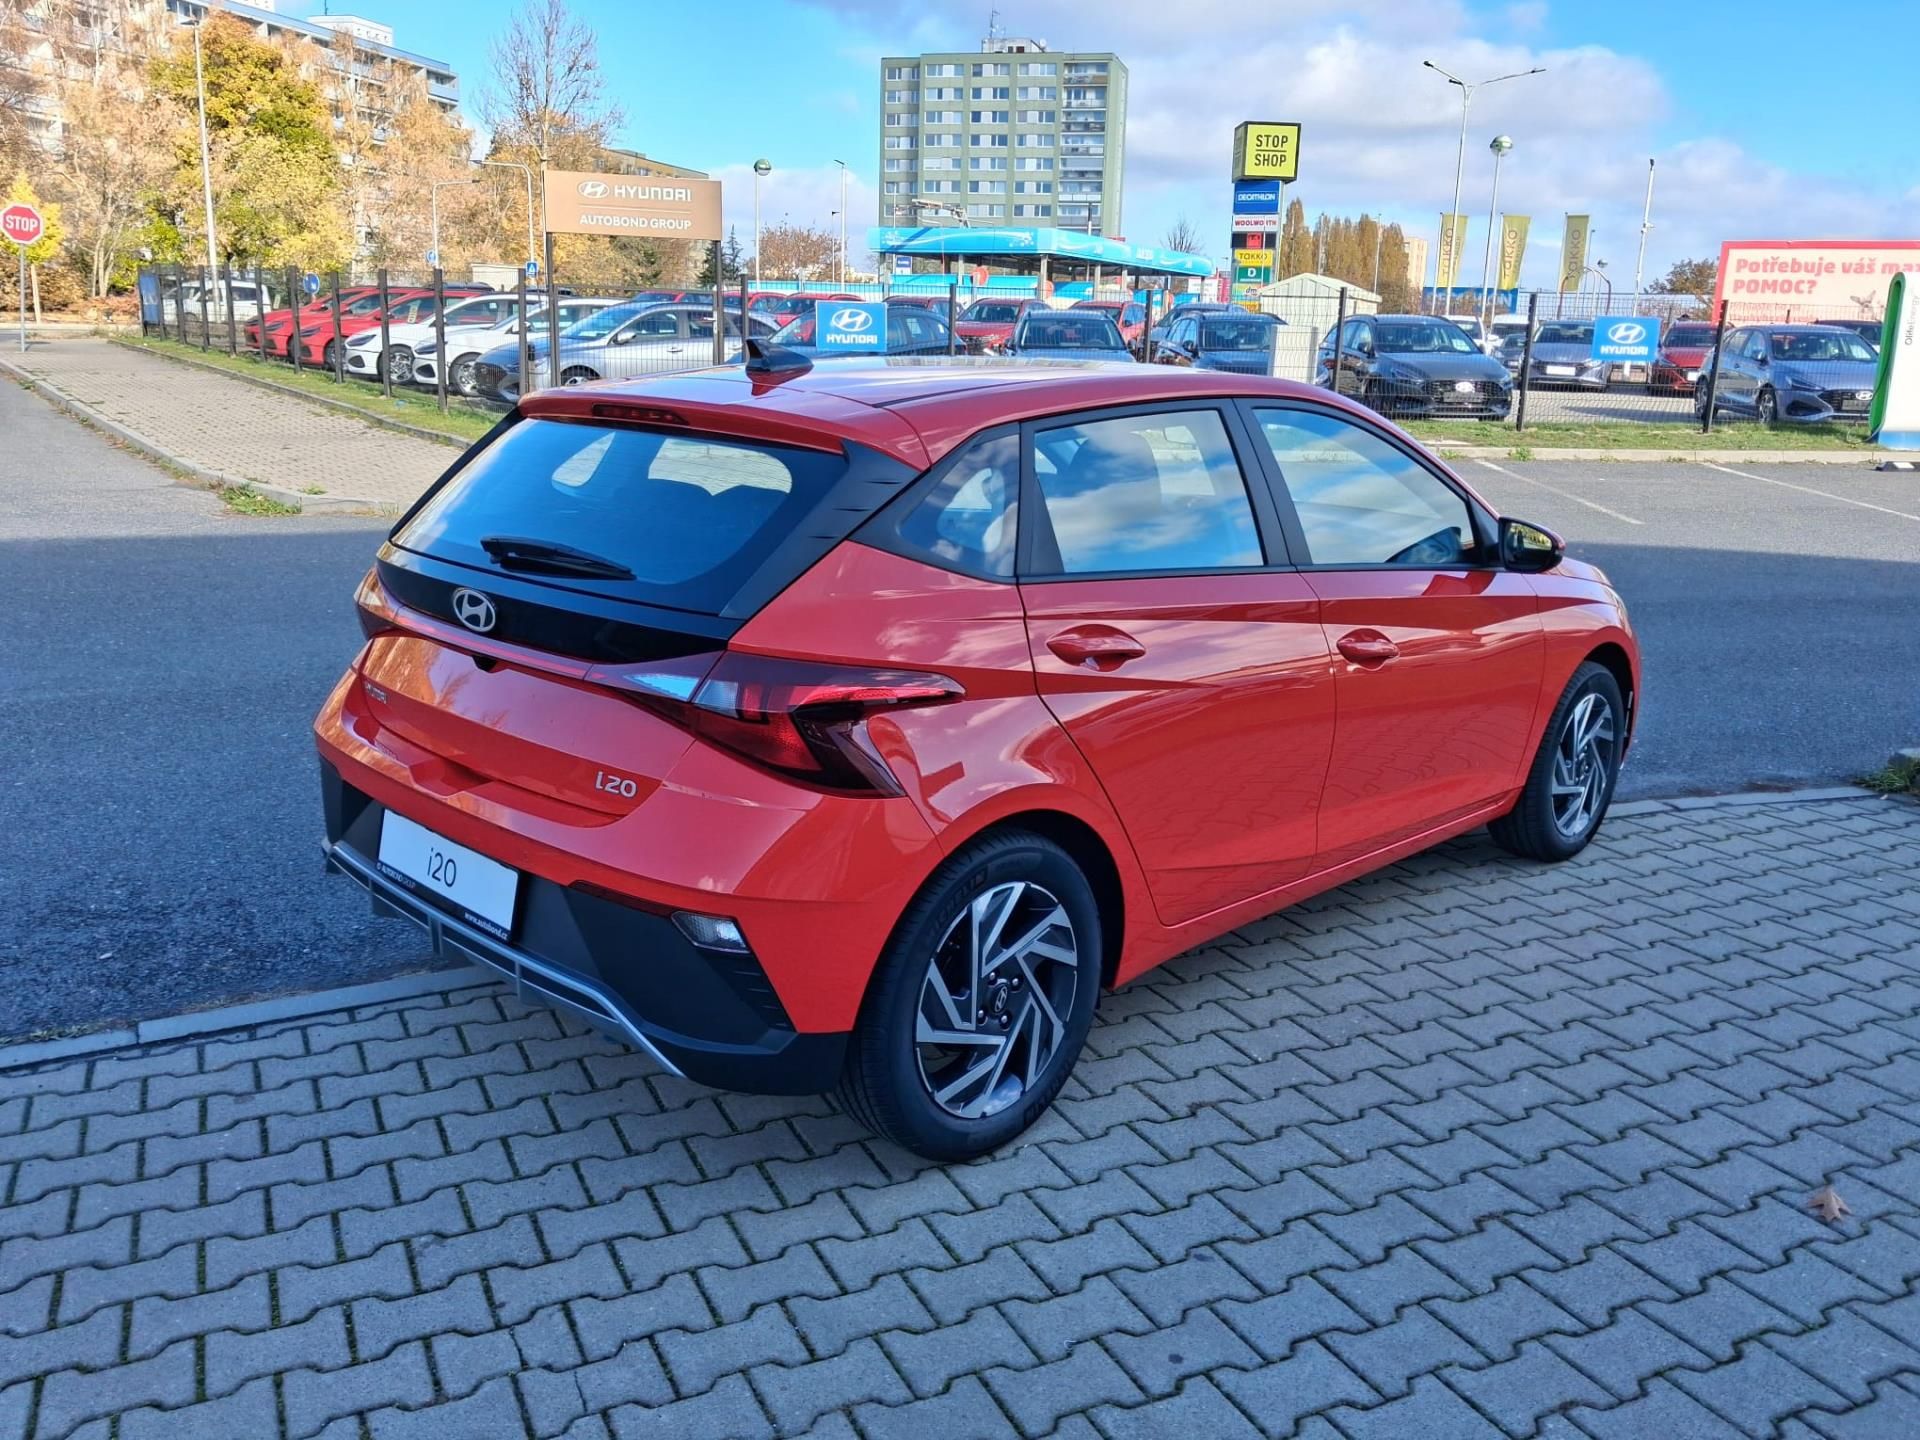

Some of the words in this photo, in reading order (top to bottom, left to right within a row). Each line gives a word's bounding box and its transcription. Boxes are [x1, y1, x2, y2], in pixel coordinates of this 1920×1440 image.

[1255, 134, 1288, 148] STOP
[1254, 153, 1287, 167] SHOP
[614, 185, 692, 202] HYUNDAI
[1237, 192, 1276, 201] DECATHLON
[5, 214, 38, 232] STOP
[580, 214, 648, 228] AUTOBOND
[650, 218, 692, 230] GROUP
[1735, 256, 1836, 277] Potřebuje
[1841, 257, 1876, 275] váš
[1732, 279, 1818, 295] POMOC?
[826, 333, 878, 345] HYUNDAI
[1600, 345, 1649, 356] HYUNDAI
[427, 847, 457, 887] i20
